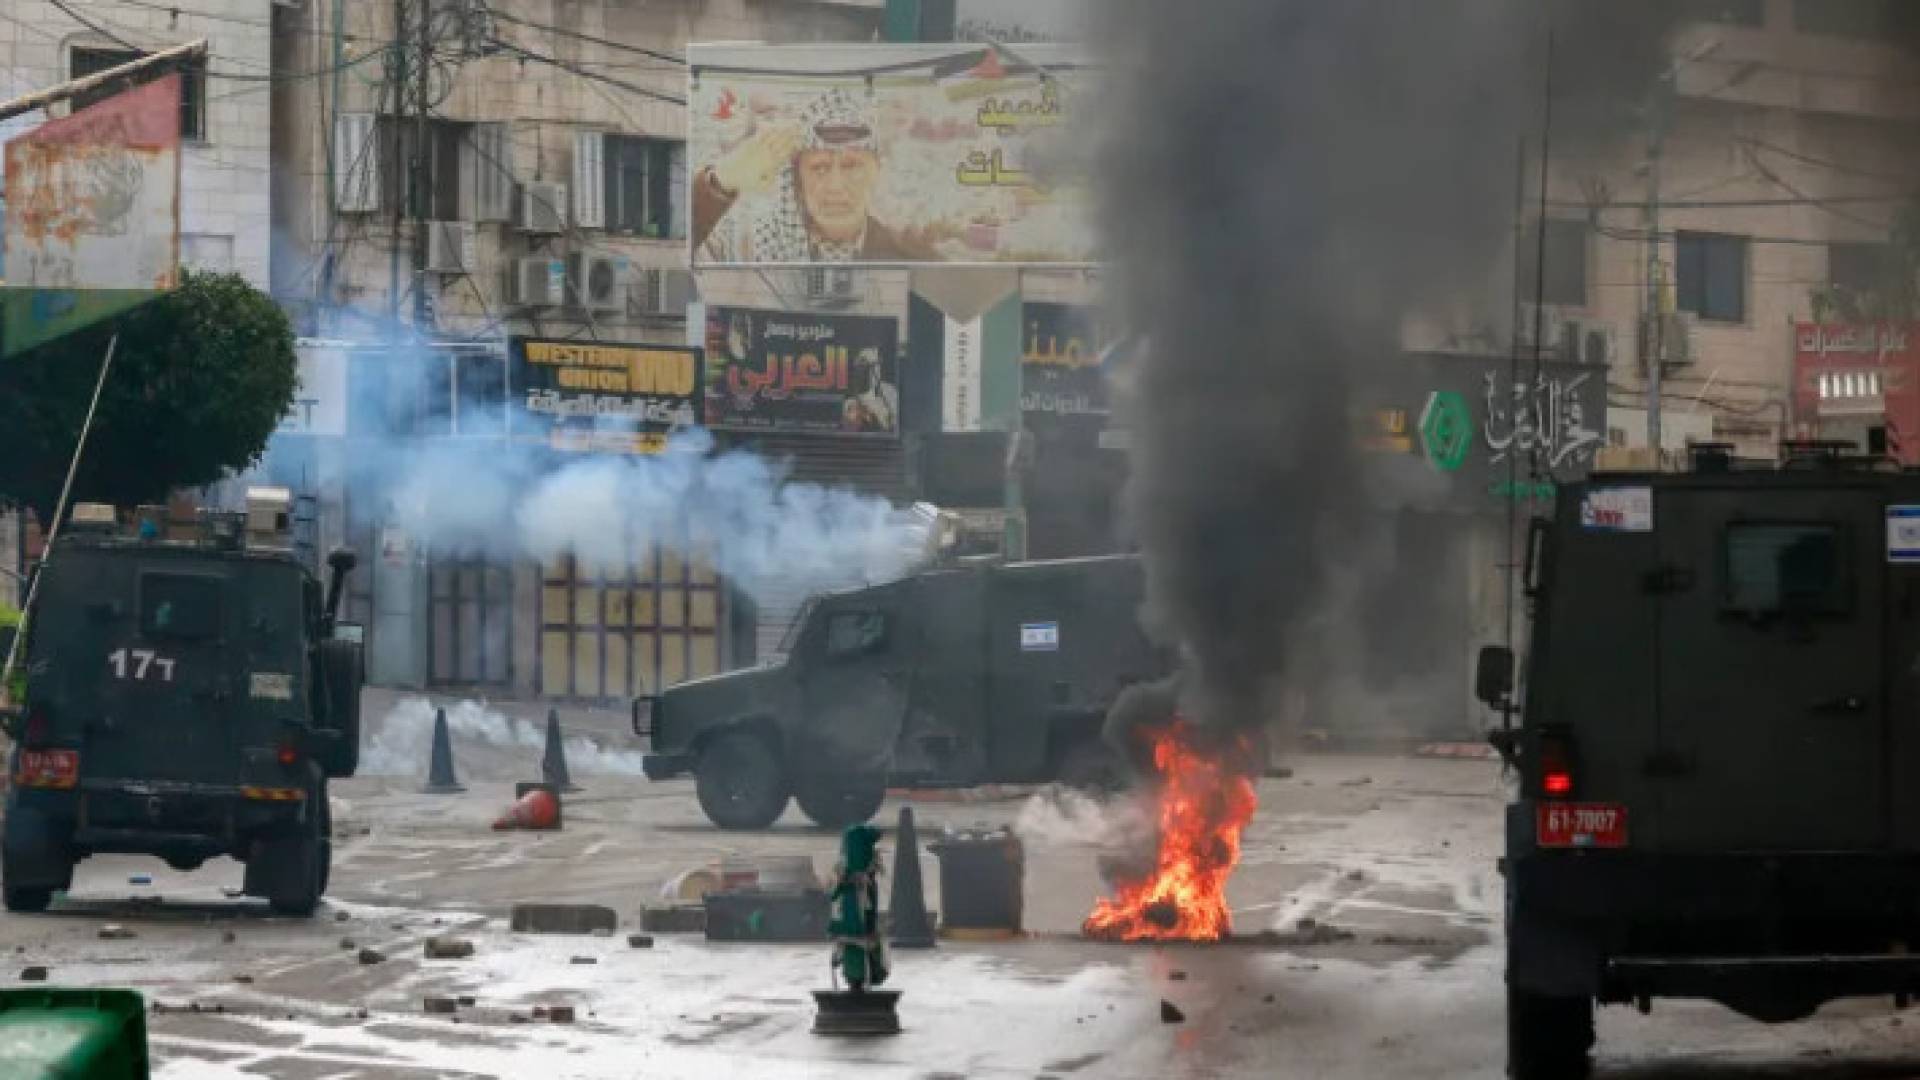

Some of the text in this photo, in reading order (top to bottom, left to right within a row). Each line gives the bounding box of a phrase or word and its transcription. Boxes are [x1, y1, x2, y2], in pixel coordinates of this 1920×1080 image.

[525, 342, 629, 366] WESTERN
[557, 366, 629, 391] UNION
[1548, 809, 1617, 832] 61-7007
